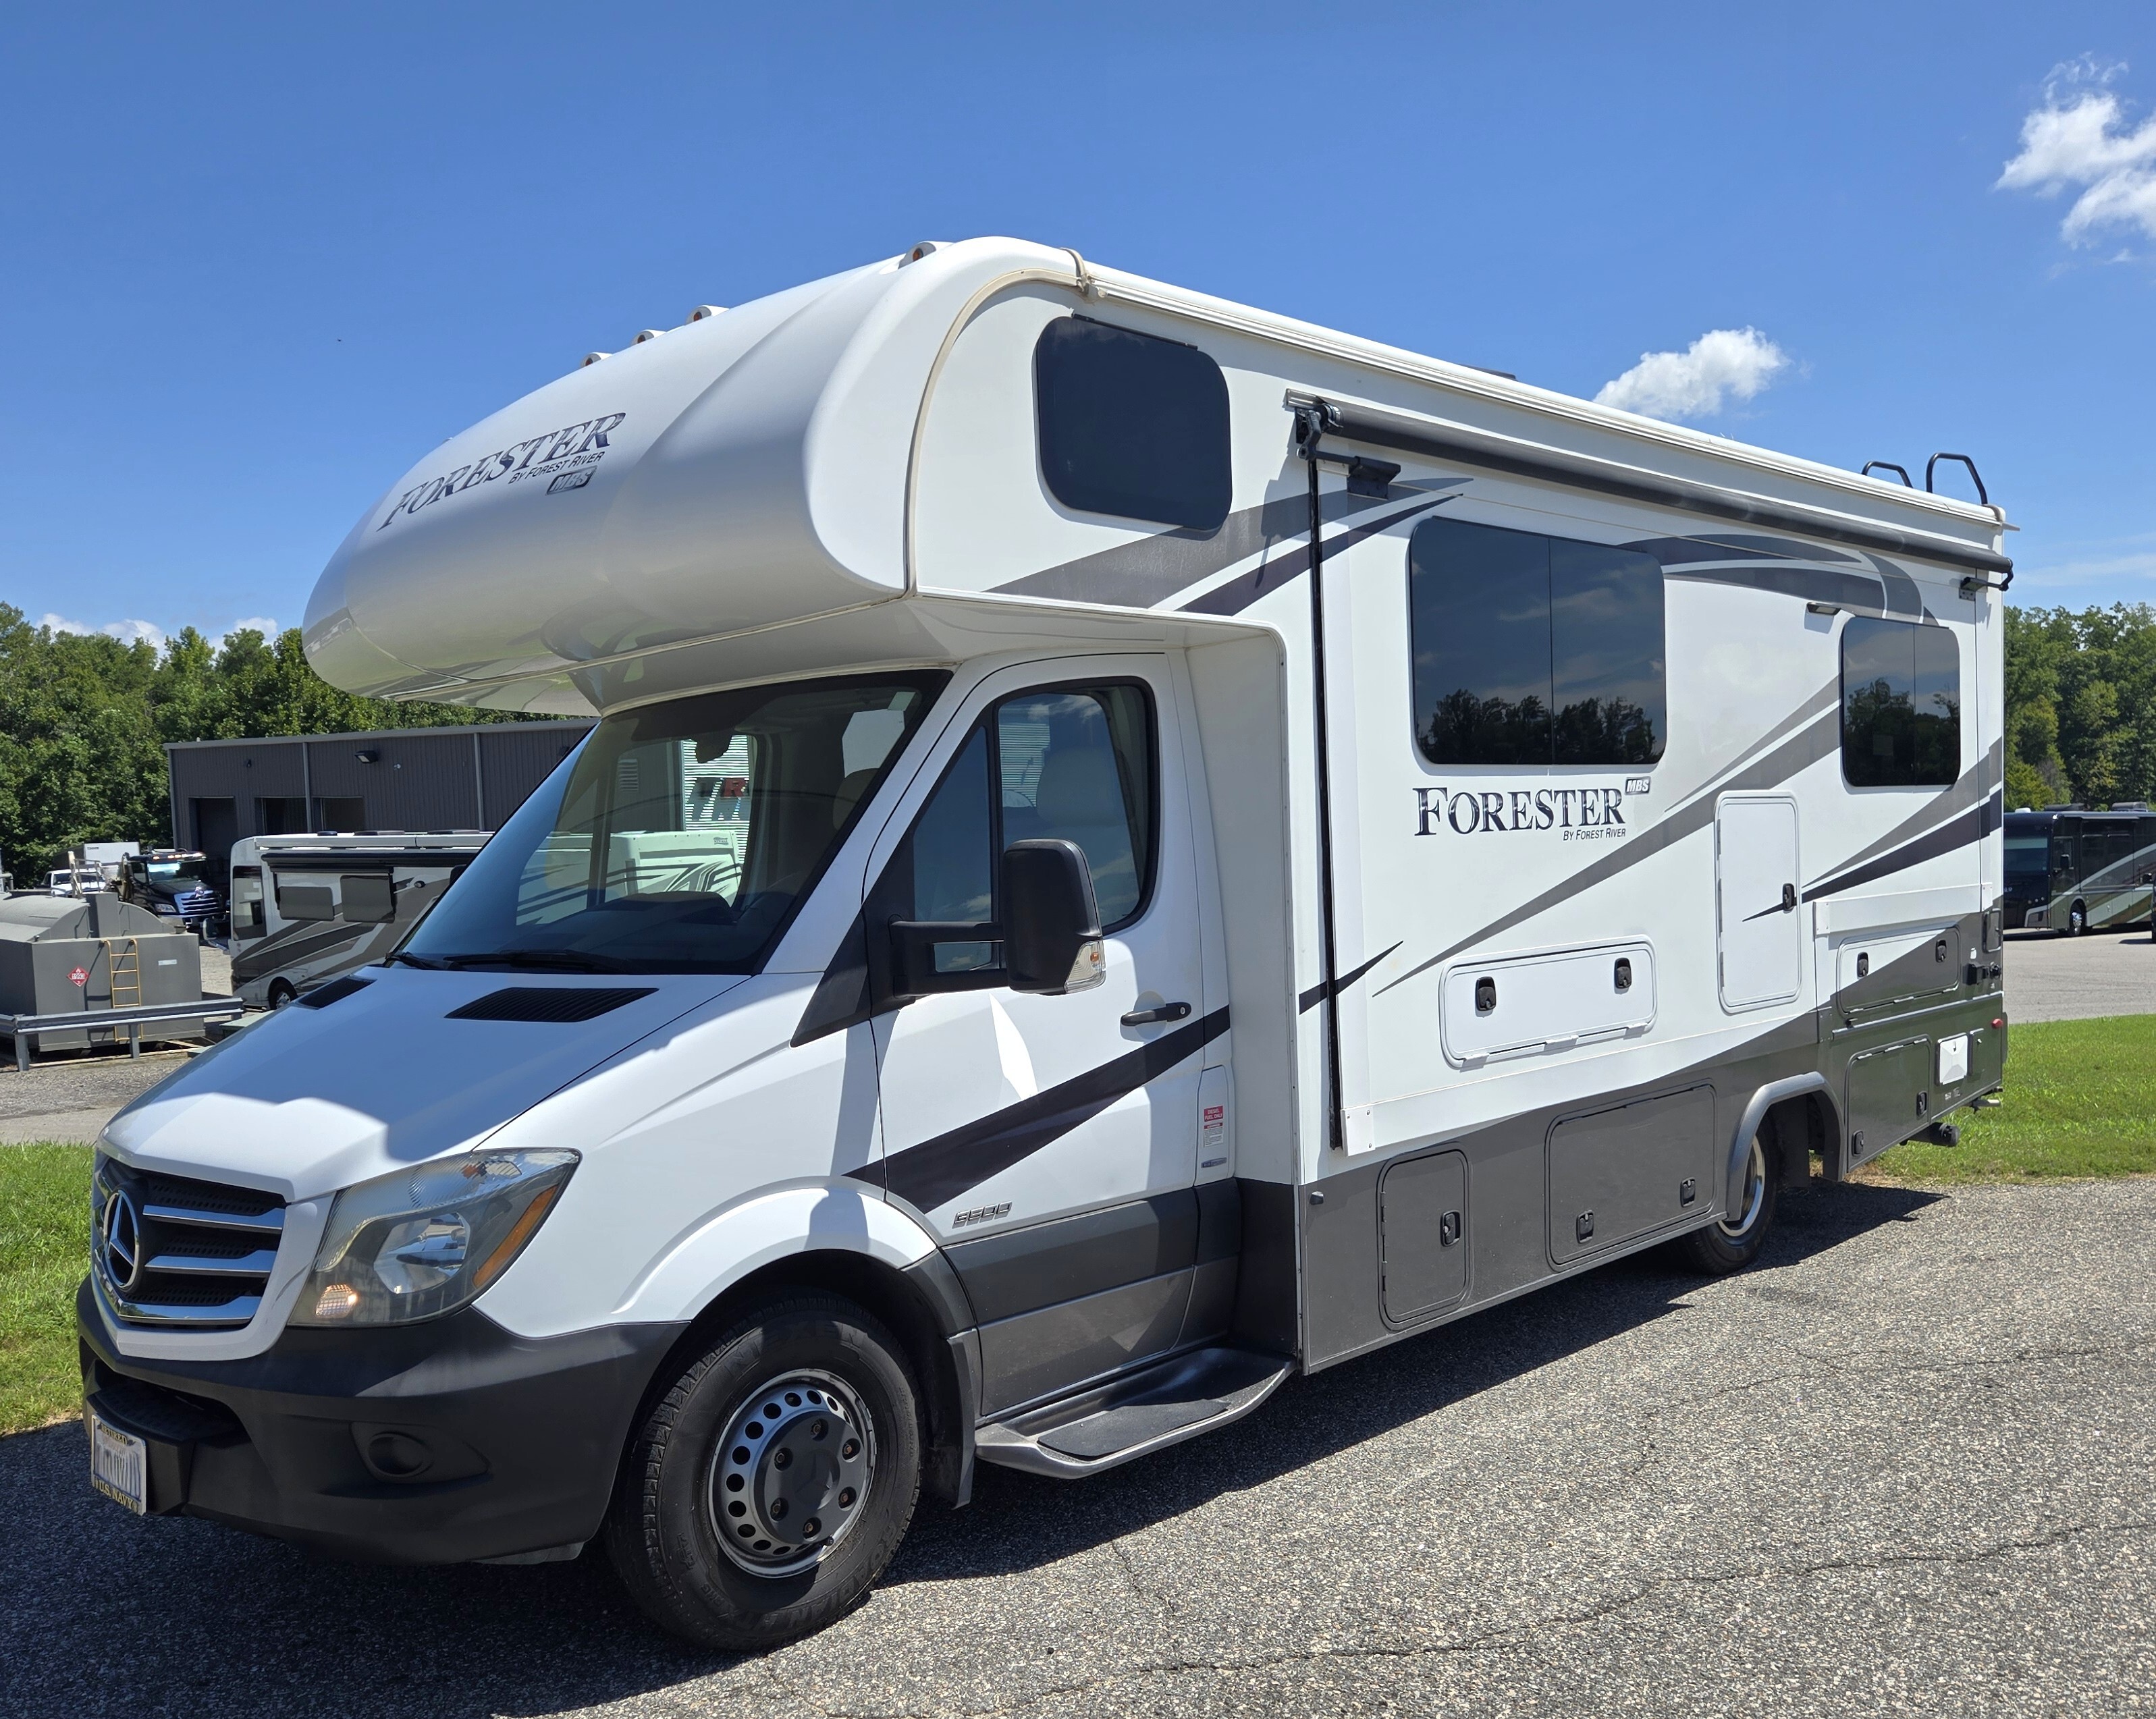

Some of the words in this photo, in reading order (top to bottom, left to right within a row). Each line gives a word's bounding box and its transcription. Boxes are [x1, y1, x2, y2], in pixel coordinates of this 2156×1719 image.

[376, 412, 626, 533] FORESTER
[509, 472, 526, 485] BY
[527, 460, 571, 479] FOREST
[570, 450, 606, 468] RIVER
[550, 470, 595, 493] MBS
[1626, 779, 1650, 793] MBS
[1412, 787, 1625, 836] FORESTER
[1563, 829, 1574, 841] BY
[1575, 829, 1604, 840] FOREST
[1606, 827, 1627, 839] RIVER
[952, 1201, 1013, 1226] 3500
[101, 1423, 128, 1446] RETIRED
[100, 1480, 111, 1498] U.S.
[111, 1487, 133, 1511] NAVY
